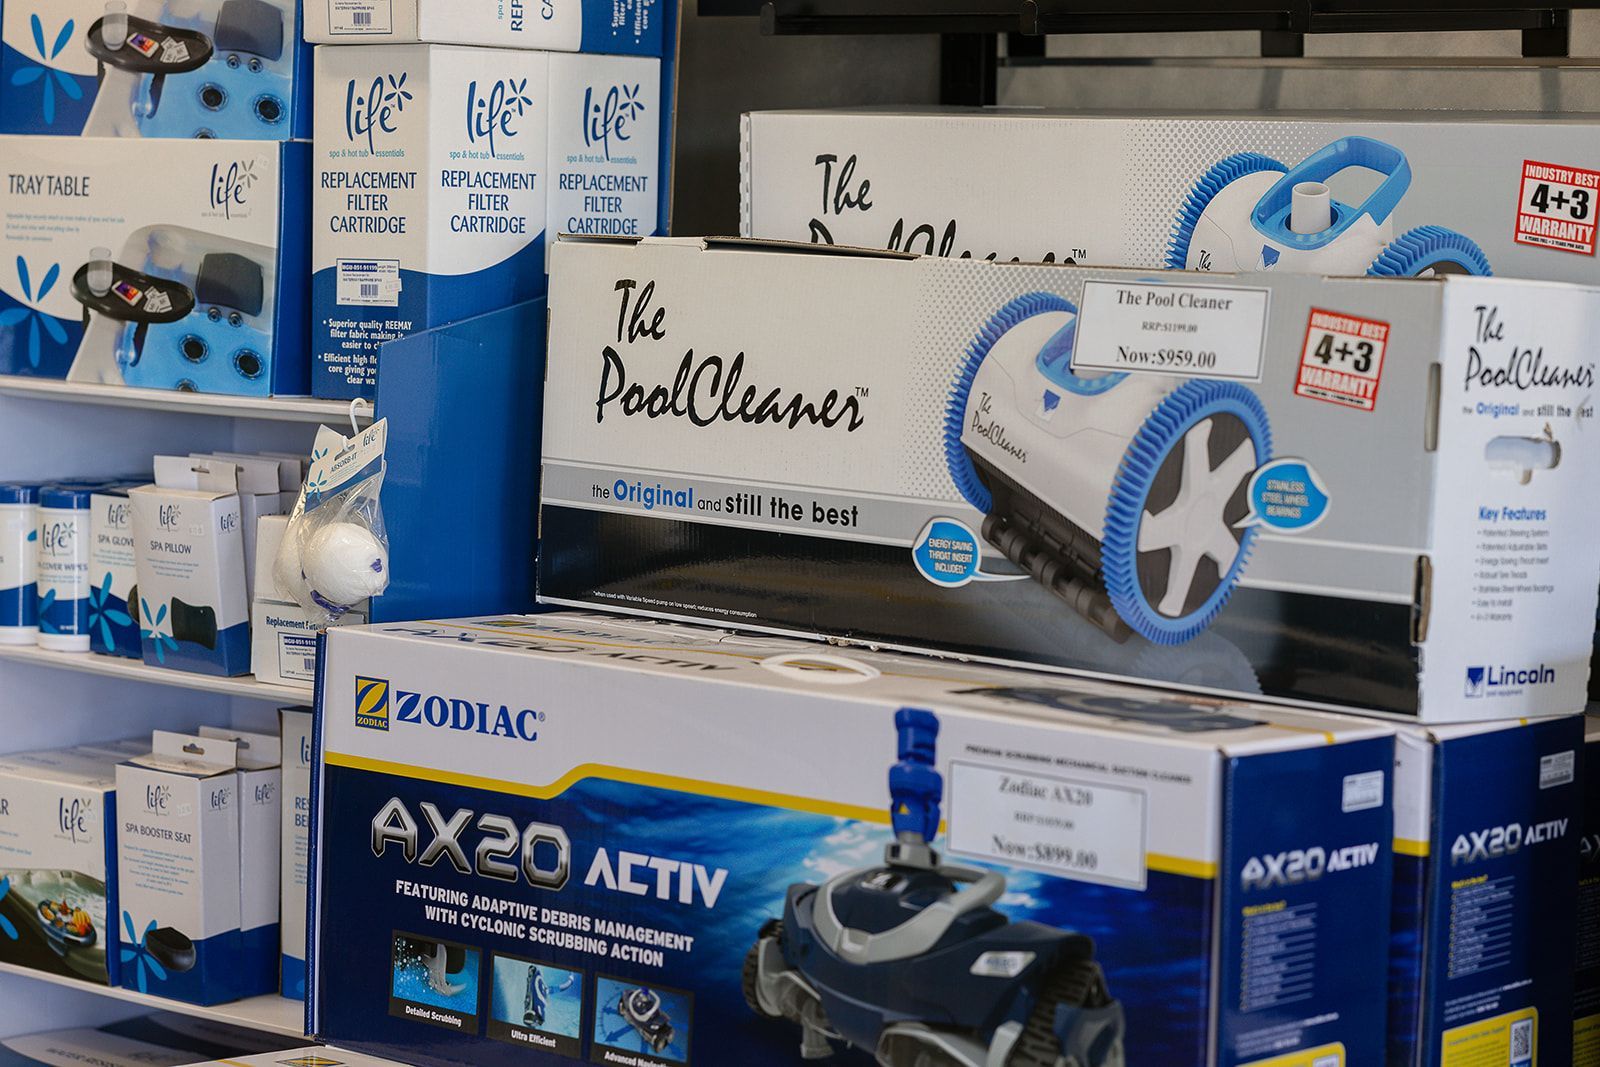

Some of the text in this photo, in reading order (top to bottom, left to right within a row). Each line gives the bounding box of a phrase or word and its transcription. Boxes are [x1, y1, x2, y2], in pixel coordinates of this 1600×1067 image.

[346, 76, 397, 155] life
[467, 80, 517, 158] life
[583, 86, 630, 161] life
[329, 149, 405, 159] spa & hot tub essentials
[449, 150, 525, 161] spa & hot tub essentials
[567, 154, 637, 164] spa & hot tub essentials
[9, 174, 91, 197] TRAY TABLE
[321, 171, 417, 189] REPLACEMENT
[441, 170, 537, 190] REPLACEMENT
[559, 173, 648, 192] REPLACEMENT
[815, 153, 873, 215] The
[1525, 164, 1600, 188] INDUSTRY BEST
[210, 162, 246, 220] life
[347, 194, 388, 211] FILTER
[468, 193, 509, 211] FILTER
[1530, 183, 1590, 220] 4+3
[584, 196, 622, 213] FILTER
[330, 216, 406, 234] CARTRIDGE
[450, 215, 526, 234] CARTRIDGE
[567, 216, 638, 235] CARTRIDGE
[1519, 214, 1594, 243] WARRANTY
[1117, 289, 1233, 310] The Pool Cleaner
[614, 279, 667, 344] The
[328, 318, 412, 331] Superior quality REEMAY
[330, 329, 347, 338] filter
[349, 330, 368, 339] fabric
[1475, 305, 1504, 343] The
[341, 340, 362, 349] easier
[364, 341, 371, 349] to
[1314, 334, 1374, 373] 4+3
[323, 353, 368, 366] Efficient high
[1116, 345, 1216, 368] Now:$959.00
[328, 365, 365, 376] core giving
[347, 375, 363, 384] clear
[1465, 346, 1594, 391] PoolCleaner
[595, 345, 864, 432] PoolCleaner
[1300, 365, 1377, 398] WARRANTY
[1476, 402, 1519, 418] Original
[592, 479, 858, 527] the Original and still the best
[1478, 506, 1547, 522] Key Features
[160, 505, 177, 532] life
[42, 523, 68, 557] life
[150, 540, 192, 554] SPA PILLOW
[266, 615, 304, 628] Replacement
[729, 610, 758, 618] consumption
[1488, 664, 1555, 686] Lincoln
[357, 716, 388, 728] ZODIAC
[396, 690, 537, 742] ZODIAC
[147, 785, 167, 816] life
[60, 797, 87, 844] life
[1524, 818, 1569, 846] ACTIV
[125, 822, 192, 844] SPA BOOSTER SEAT
[371, 797, 572, 891] AX20
[1451, 822, 1522, 866] AX20
[1326, 842, 1379, 873] ACTIV
[583, 847, 729, 909] ACTIV
[1241, 847, 1326, 892] AX20
[395, 879, 694, 953] FEATURING ADAPTIVE DEBRIS MANAGEMENT
[425, 905, 664, 968] WITH CYCLONIC SCRUBBING ACTION
[405, 1005, 462, 1028] Detailed Scrubbing
[511, 1030, 556, 1048] Ultra Efficient
[604, 1051, 637, 1066] Advanced
